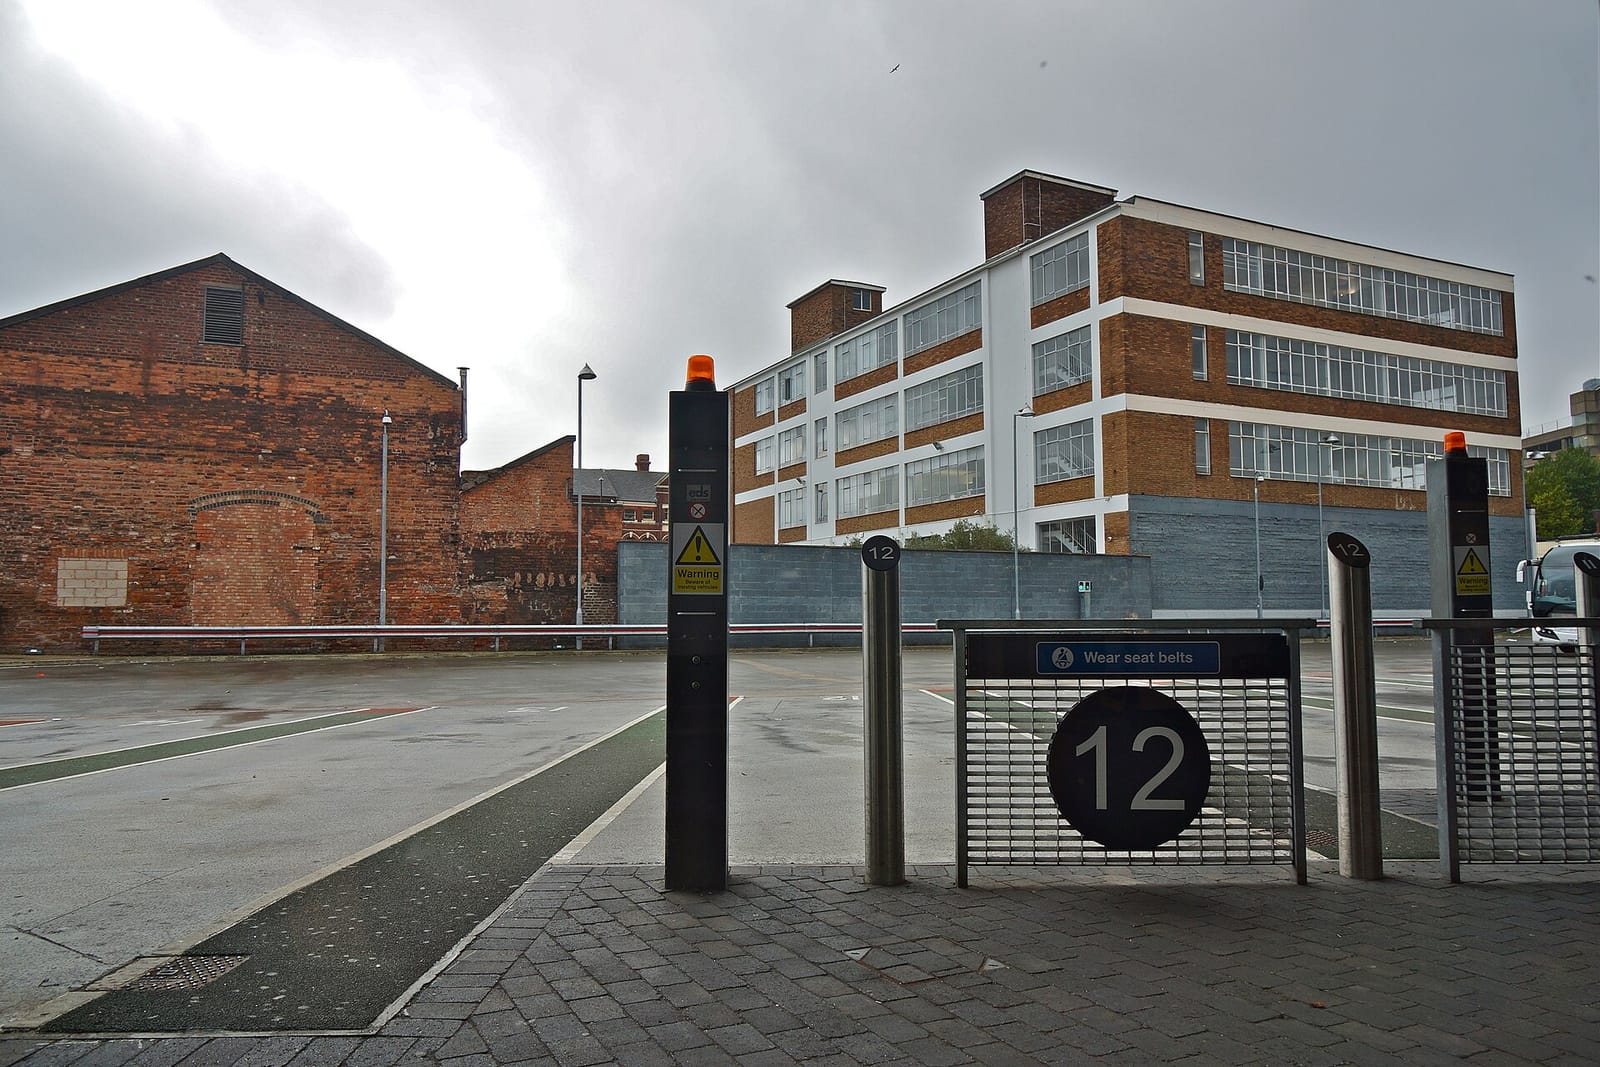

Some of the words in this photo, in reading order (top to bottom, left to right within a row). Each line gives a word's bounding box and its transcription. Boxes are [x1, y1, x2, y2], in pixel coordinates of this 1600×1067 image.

[868, 546, 895, 560] 12
[1335, 543, 1365, 557] 12
[677, 569, 719, 581] Warning
[1459, 576, 1488, 586] Warning
[1083, 651, 1121, 664] Wear
[1124, 651, 1155, 664] seat
[1158, 651, 1193, 664] belts
[1075, 725, 1186, 811] 12
